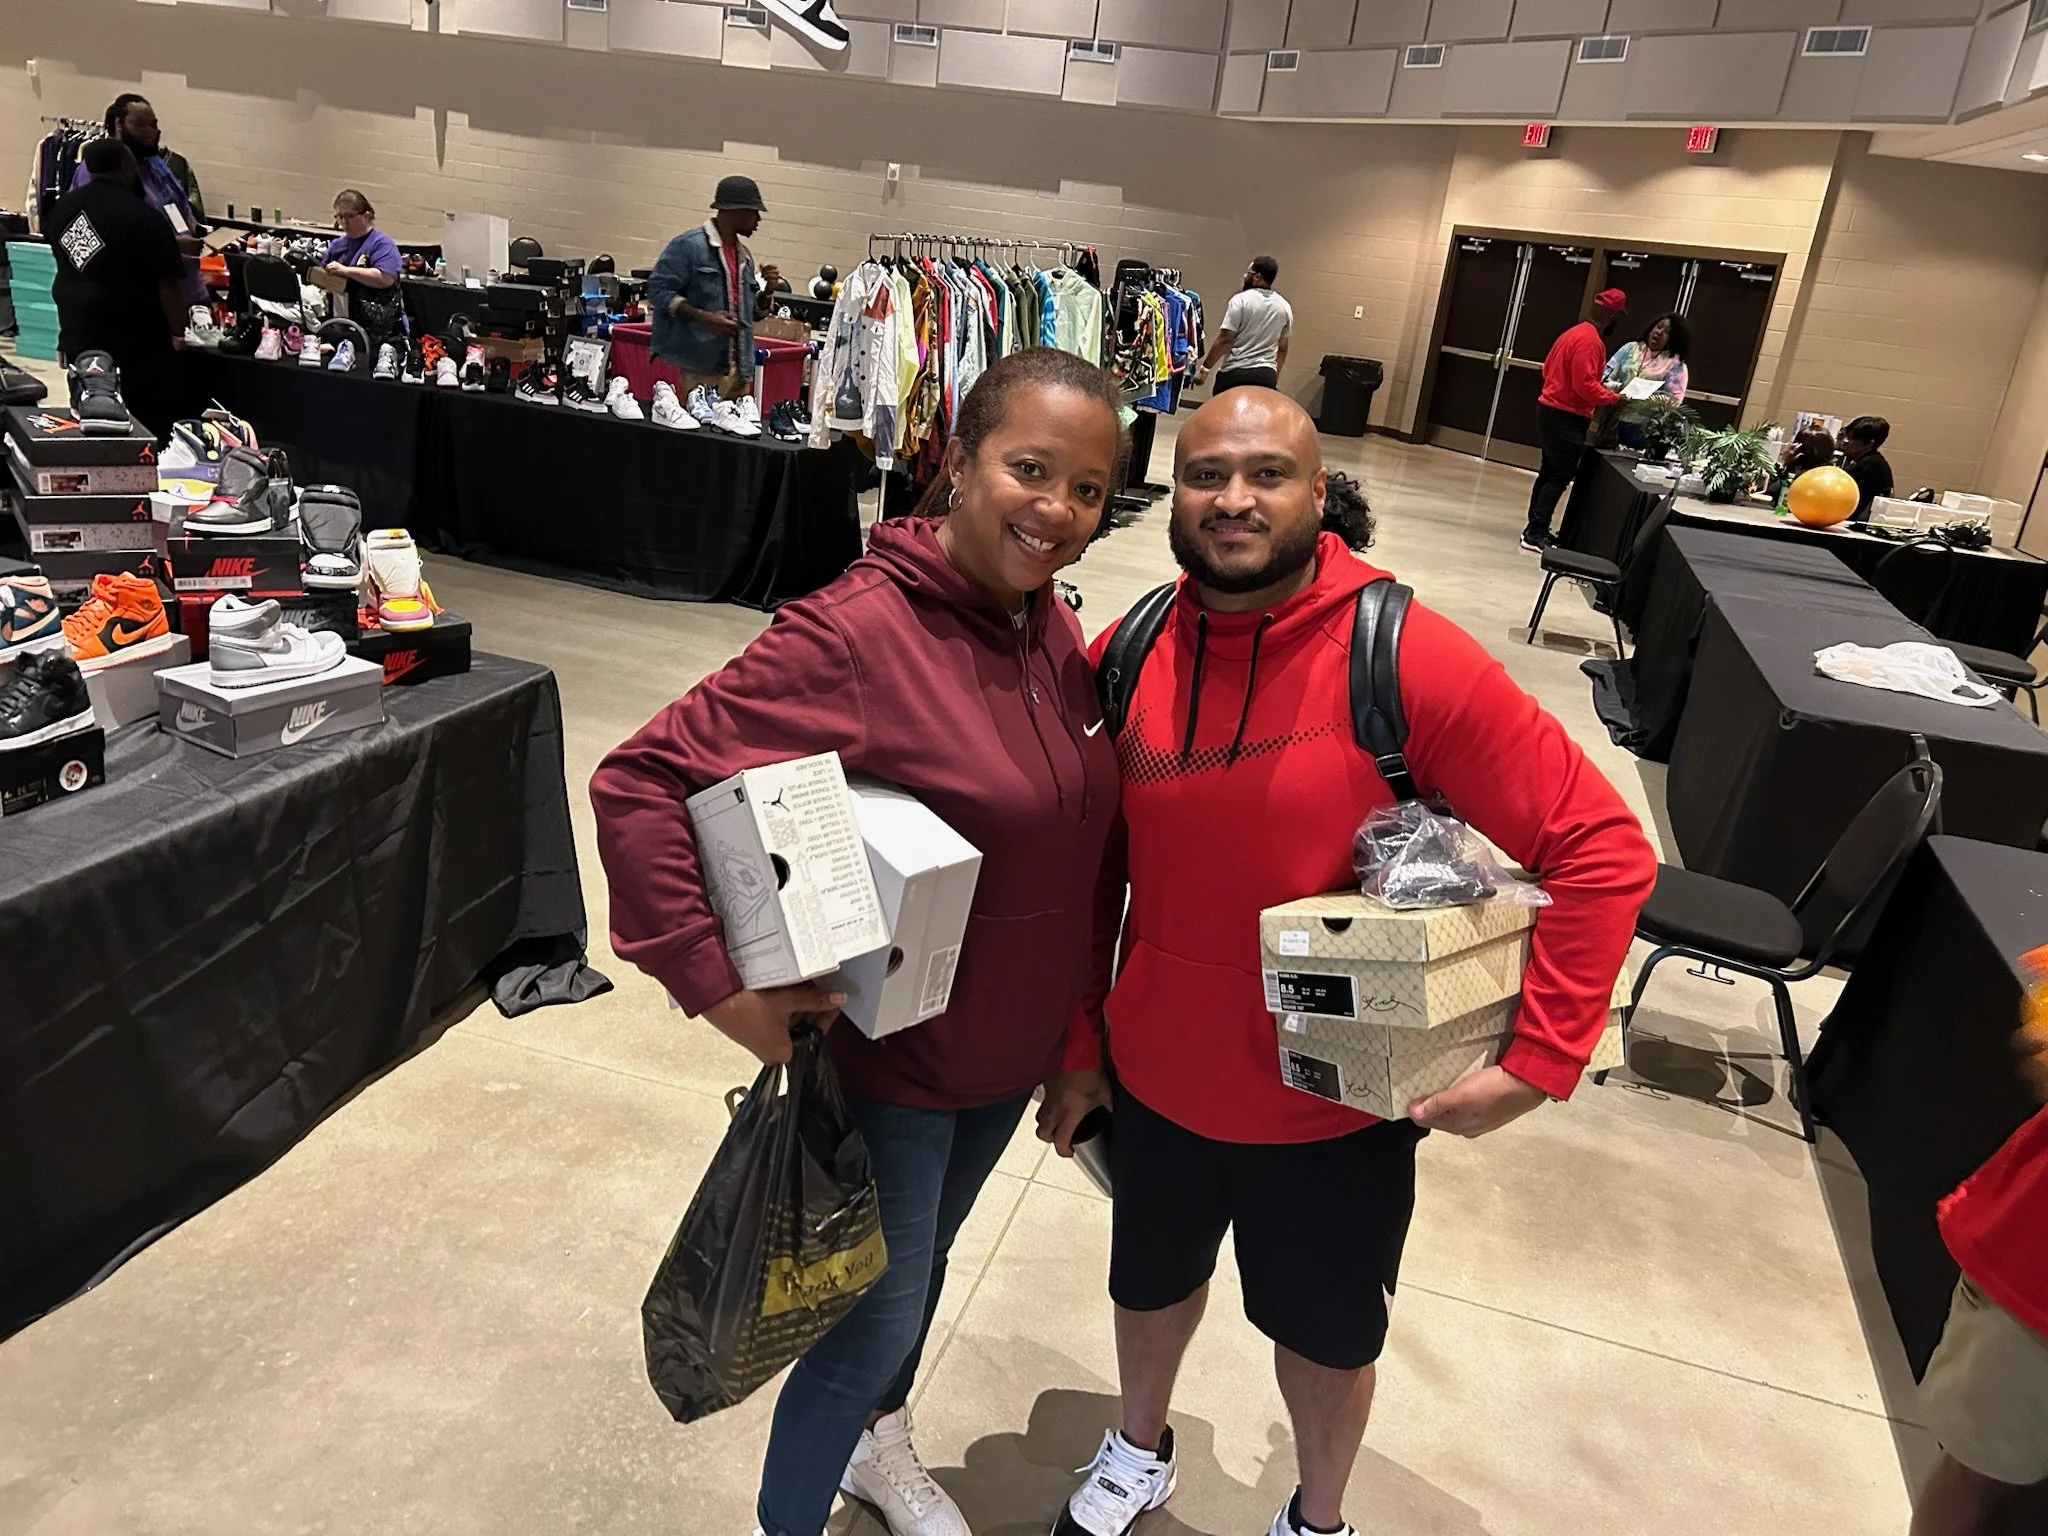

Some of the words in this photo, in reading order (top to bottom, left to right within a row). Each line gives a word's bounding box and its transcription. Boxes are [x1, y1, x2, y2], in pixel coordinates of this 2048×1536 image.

[1524, 124, 1547, 145] EXIT
[1687, 127, 1714, 150] EXIT
[211, 558, 254, 576] NIKE
[383, 650, 417, 671] NIKE
[179, 700, 207, 722] NIKE
[288, 700, 326, 729] NIKE
[1280, 984, 1294, 994] 8.5
[844, 1251, 874, 1280] You
